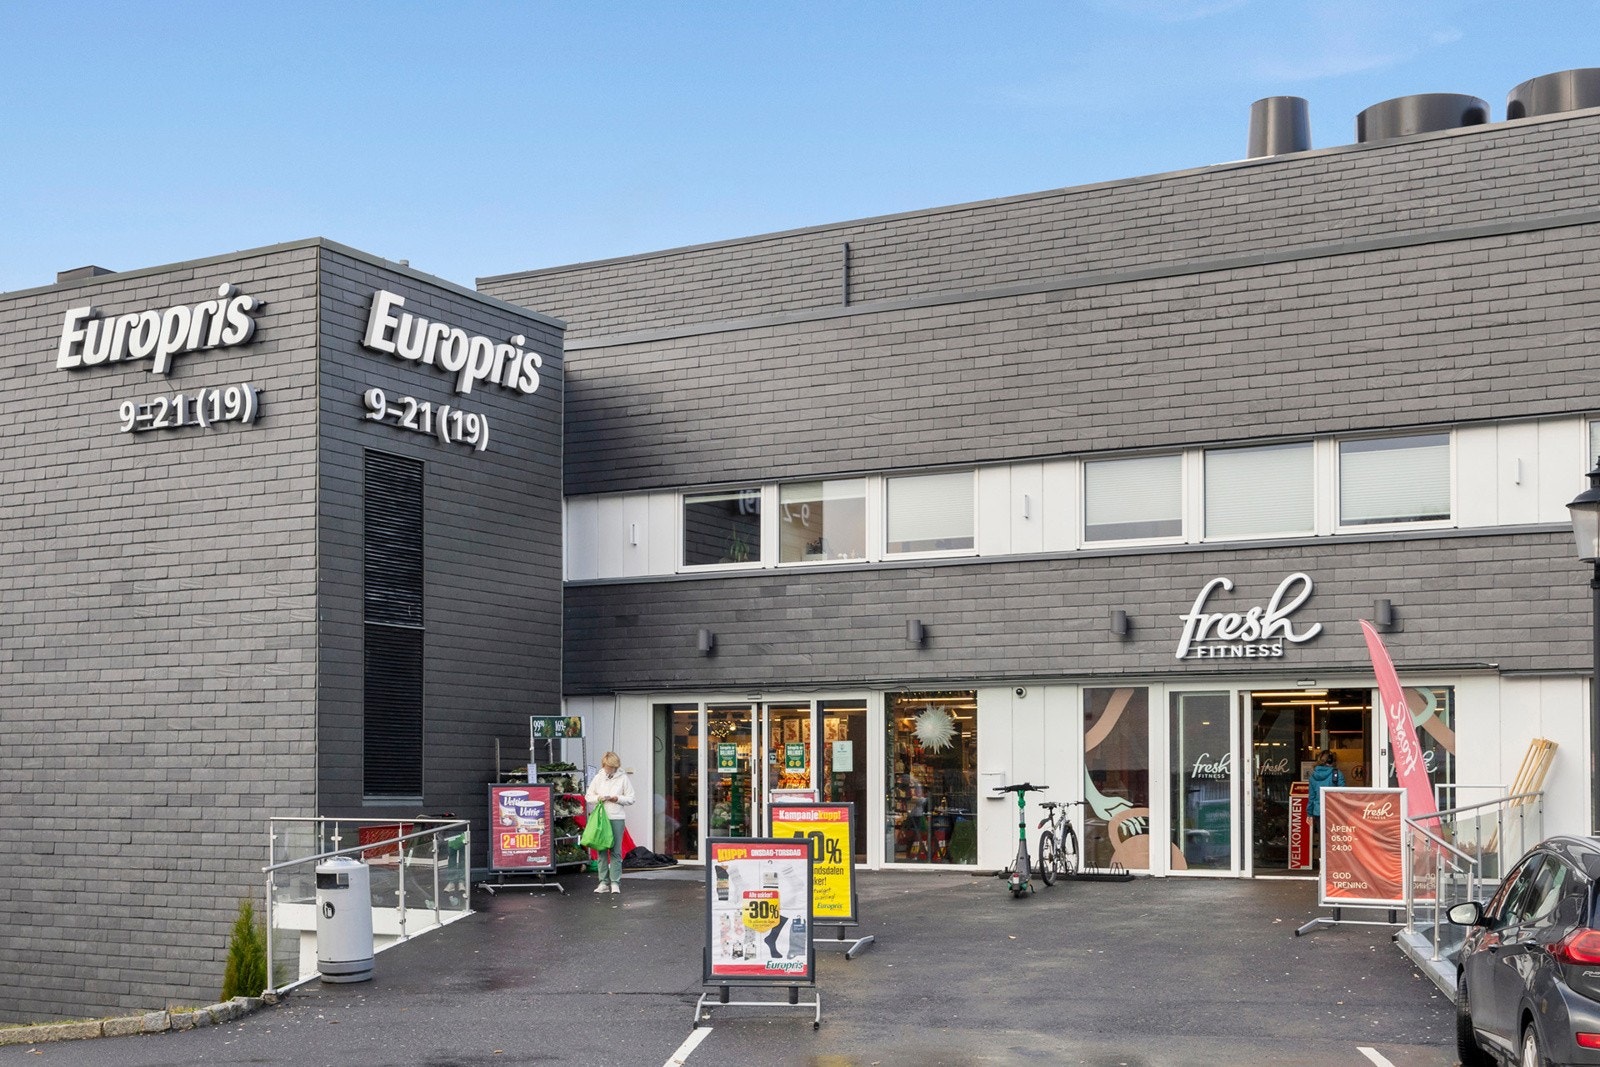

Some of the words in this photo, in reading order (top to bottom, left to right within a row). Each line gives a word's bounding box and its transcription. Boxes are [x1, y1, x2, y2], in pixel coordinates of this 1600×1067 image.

[56, 282, 260, 375] Europris
[364, 289, 543, 395] Europris
[196, 383, 258, 428] (19)
[437, 404, 490, 452] (19)
[1175, 572, 1323, 659] fresh
[1197, 643, 1283, 659] FITNESS
[1191, 752, 1231, 779] fresh
[1260, 758, 1290, 775] fresh
[1362, 802, 1394, 820] fresh
[1291, 798, 1303, 868] VELKOMMEN
[1331, 824, 1356, 833] ÅPENT
[718, 848, 747, 862] KUPP!
[1331, 844, 1352, 852] 24:00
[1332, 871, 1351, 880] GOD
[1333, 881, 1368, 889] TRENING
[745, 901, 779, 919] -30%
[765, 960, 804, 972] Europris
